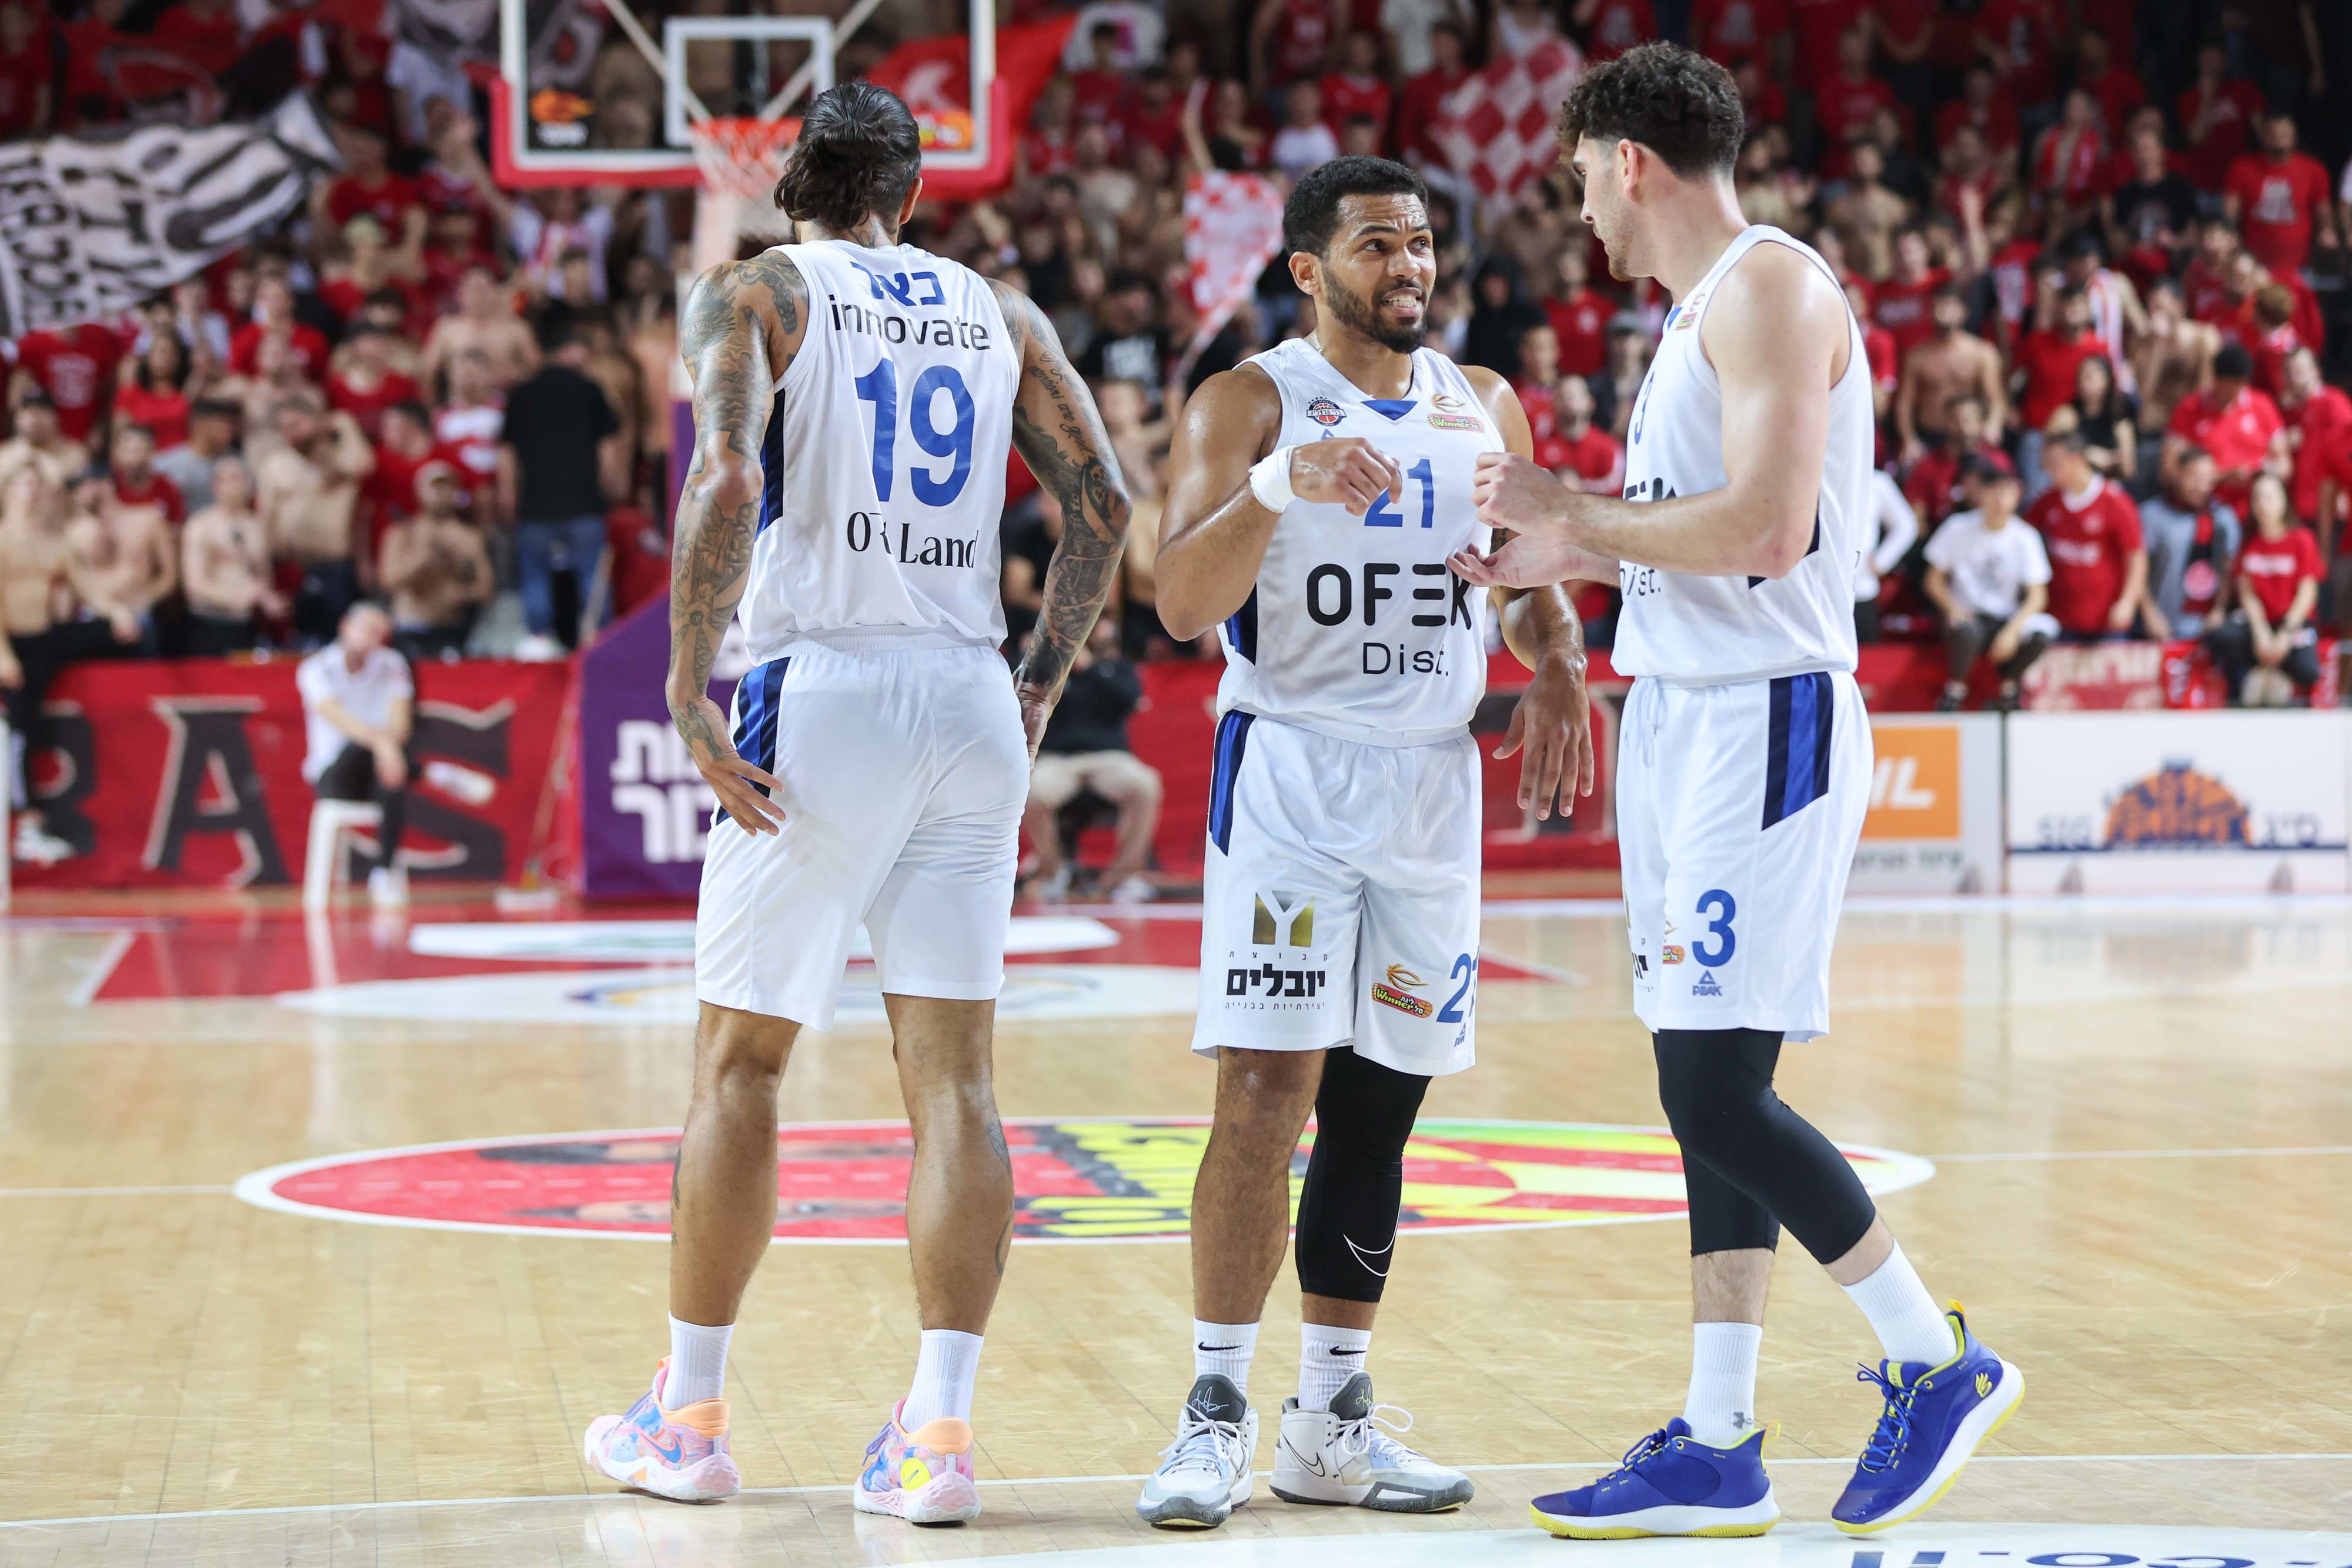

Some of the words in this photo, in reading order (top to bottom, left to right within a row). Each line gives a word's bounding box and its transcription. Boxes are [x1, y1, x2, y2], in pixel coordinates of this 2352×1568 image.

[830, 295, 991, 350] innovate
[854, 357, 975, 507] 19
[1434, 417, 1470, 428] Winner
[898, 523, 979, 569] Land
[1307, 563, 1471, 630] OFEK
[1362, 642, 1449, 676] Dist.
[1692, 888, 1736, 967] 3
[1228, 951, 1328, 962] קבוצת
[1226, 963, 1326, 997] יובלים
[1692, 985, 1723, 997] PEAK
[1375, 987, 1415, 1010] Winner
[1414, 1005, 1424, 1015] סל
[1400, 995, 1415, 1005] ליגת
